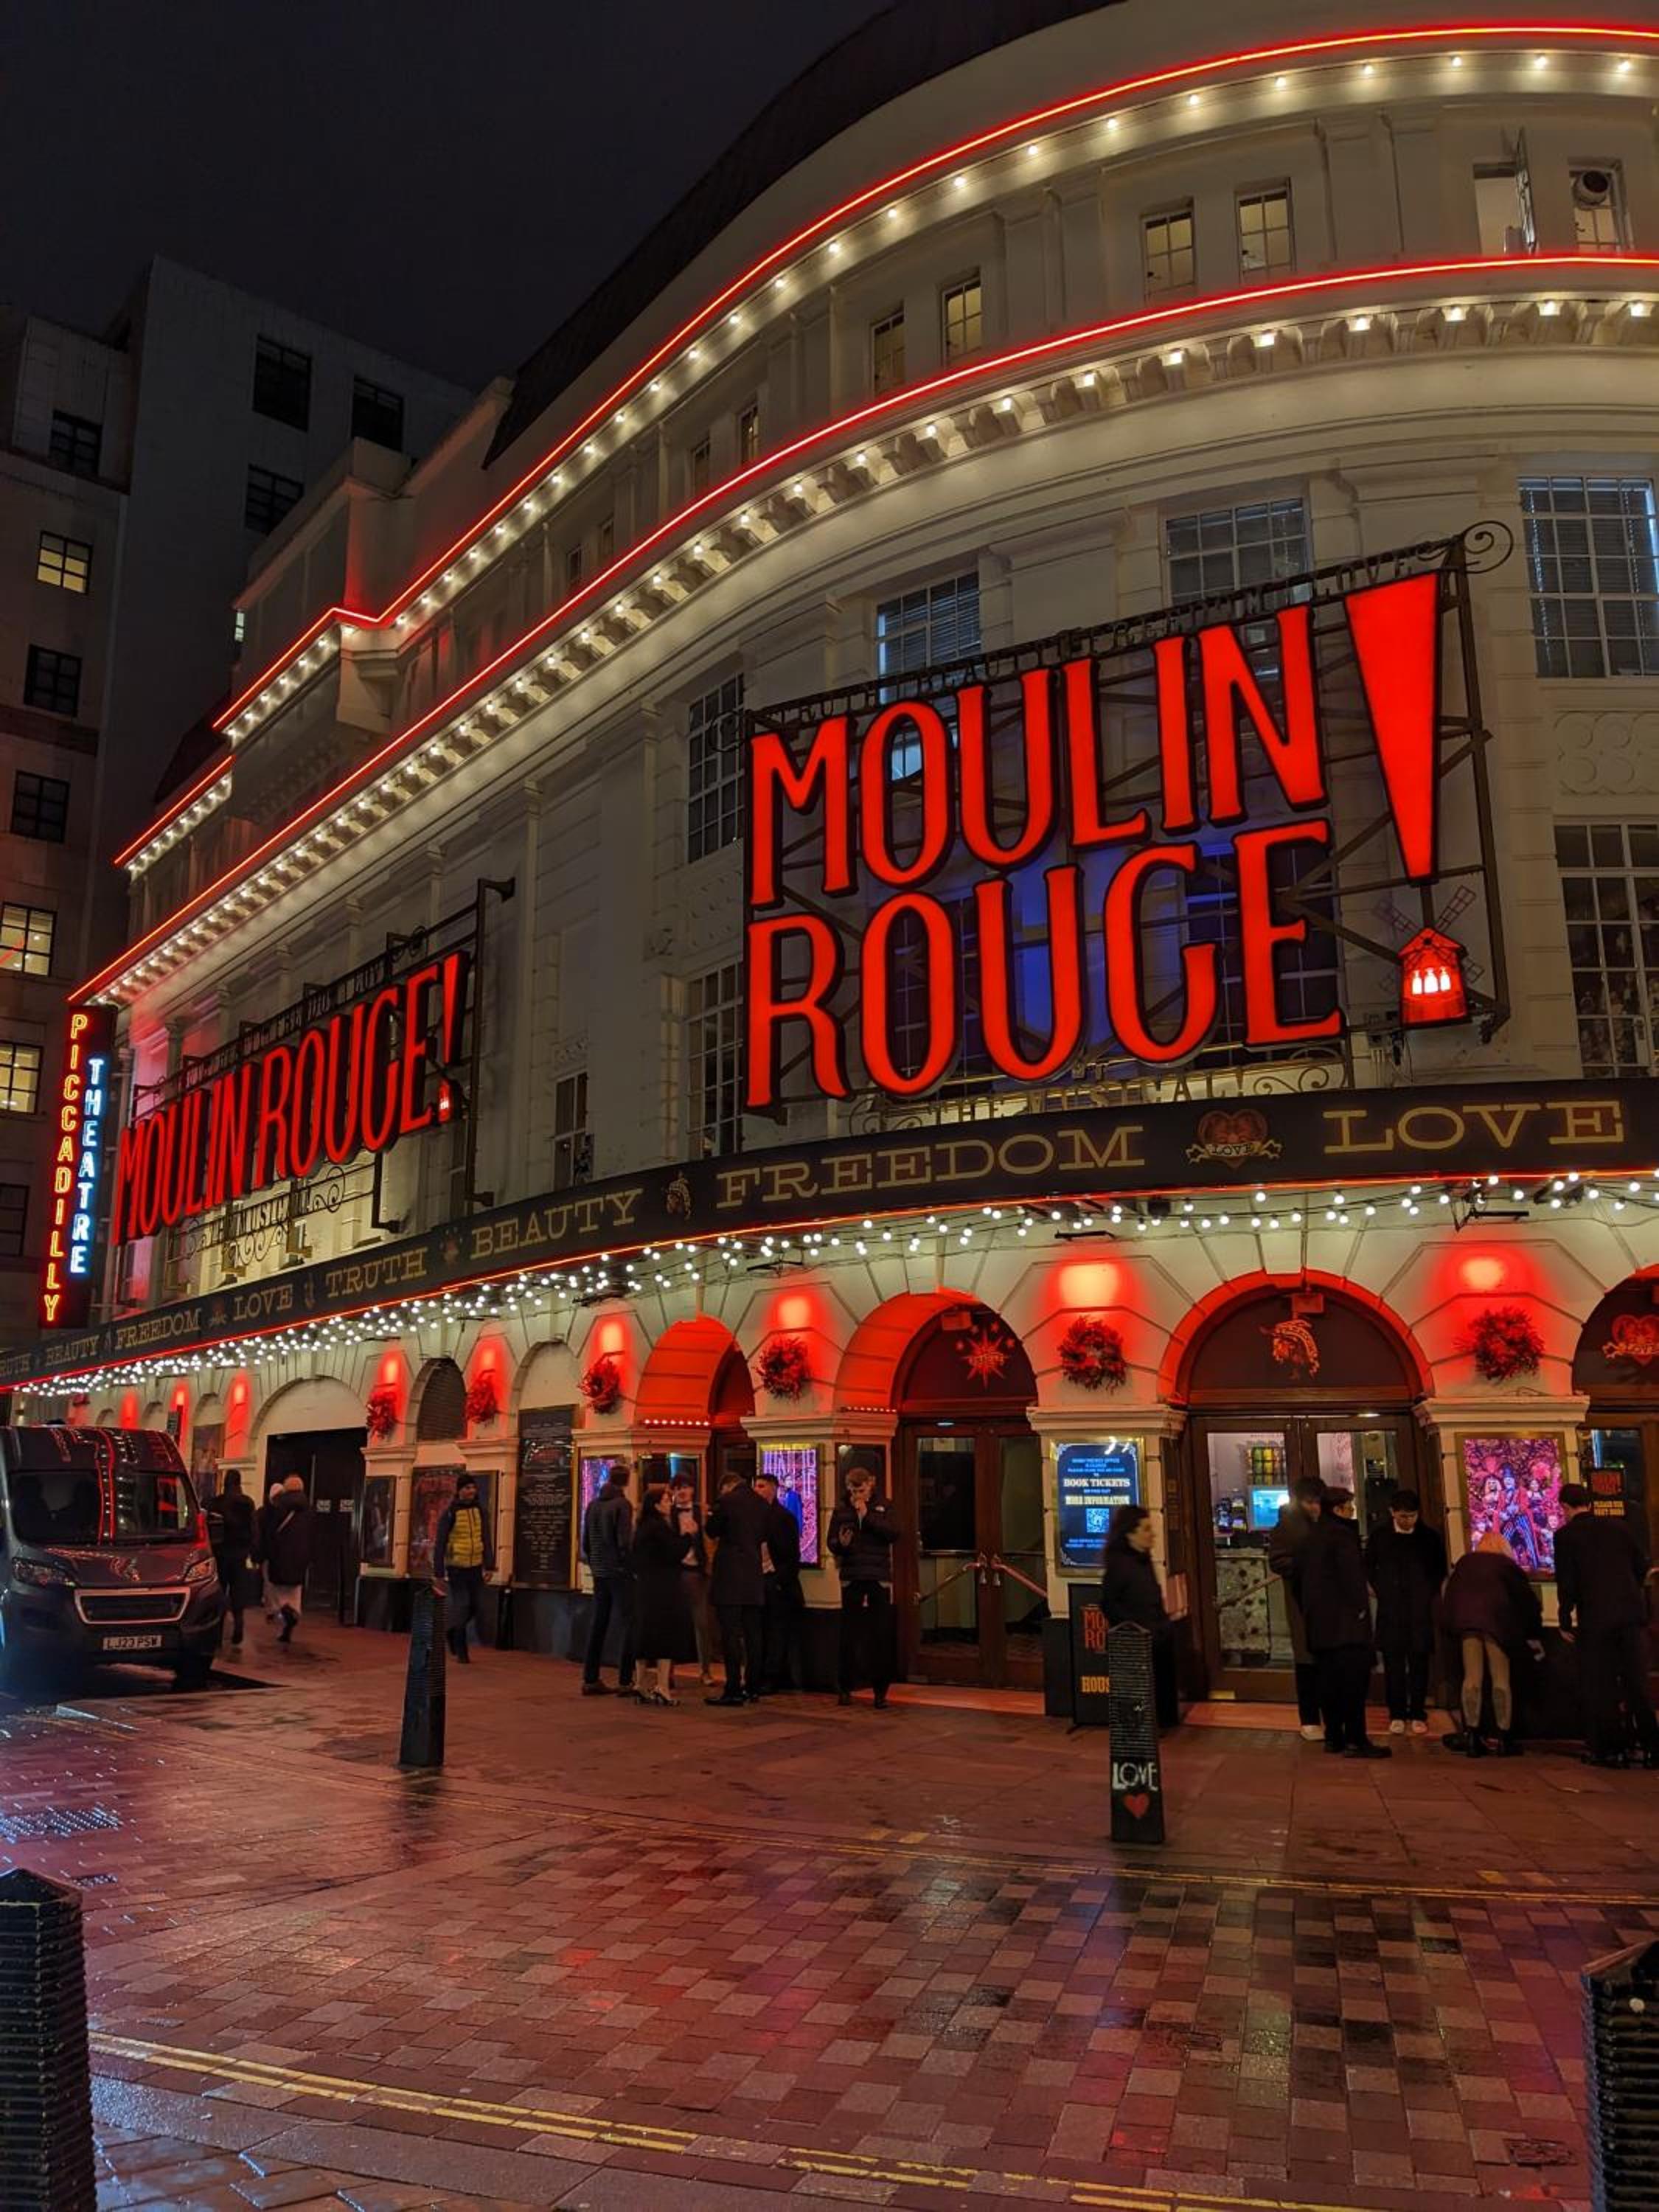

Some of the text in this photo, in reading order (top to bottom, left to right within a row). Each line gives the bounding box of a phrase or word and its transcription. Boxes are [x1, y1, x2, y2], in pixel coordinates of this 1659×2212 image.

[749, 605, 1325, 907] MOULIN
[44, 1013, 88, 1322] PICCADILLY
[70, 1059, 104, 1273] THEATRE
[112, 1060, 254, 1246] MOULIN
[115, 1309, 201, 1350] FREEDOM
[233, 1284, 293, 1321] LOVE
[326, 1248, 428, 1298] TRUTH
[470, 1188, 644, 1259] BEAUTY
[717, 1125, 1145, 1210] FREEDOM
[1324, 1100, 1624, 1154] LOVE
[1210, 1144, 1251, 1155] LOVE
[1063, 1478, 1130, 1487] BOOK TICKETS
[1112, 1761, 1158, 1792] LOVE
